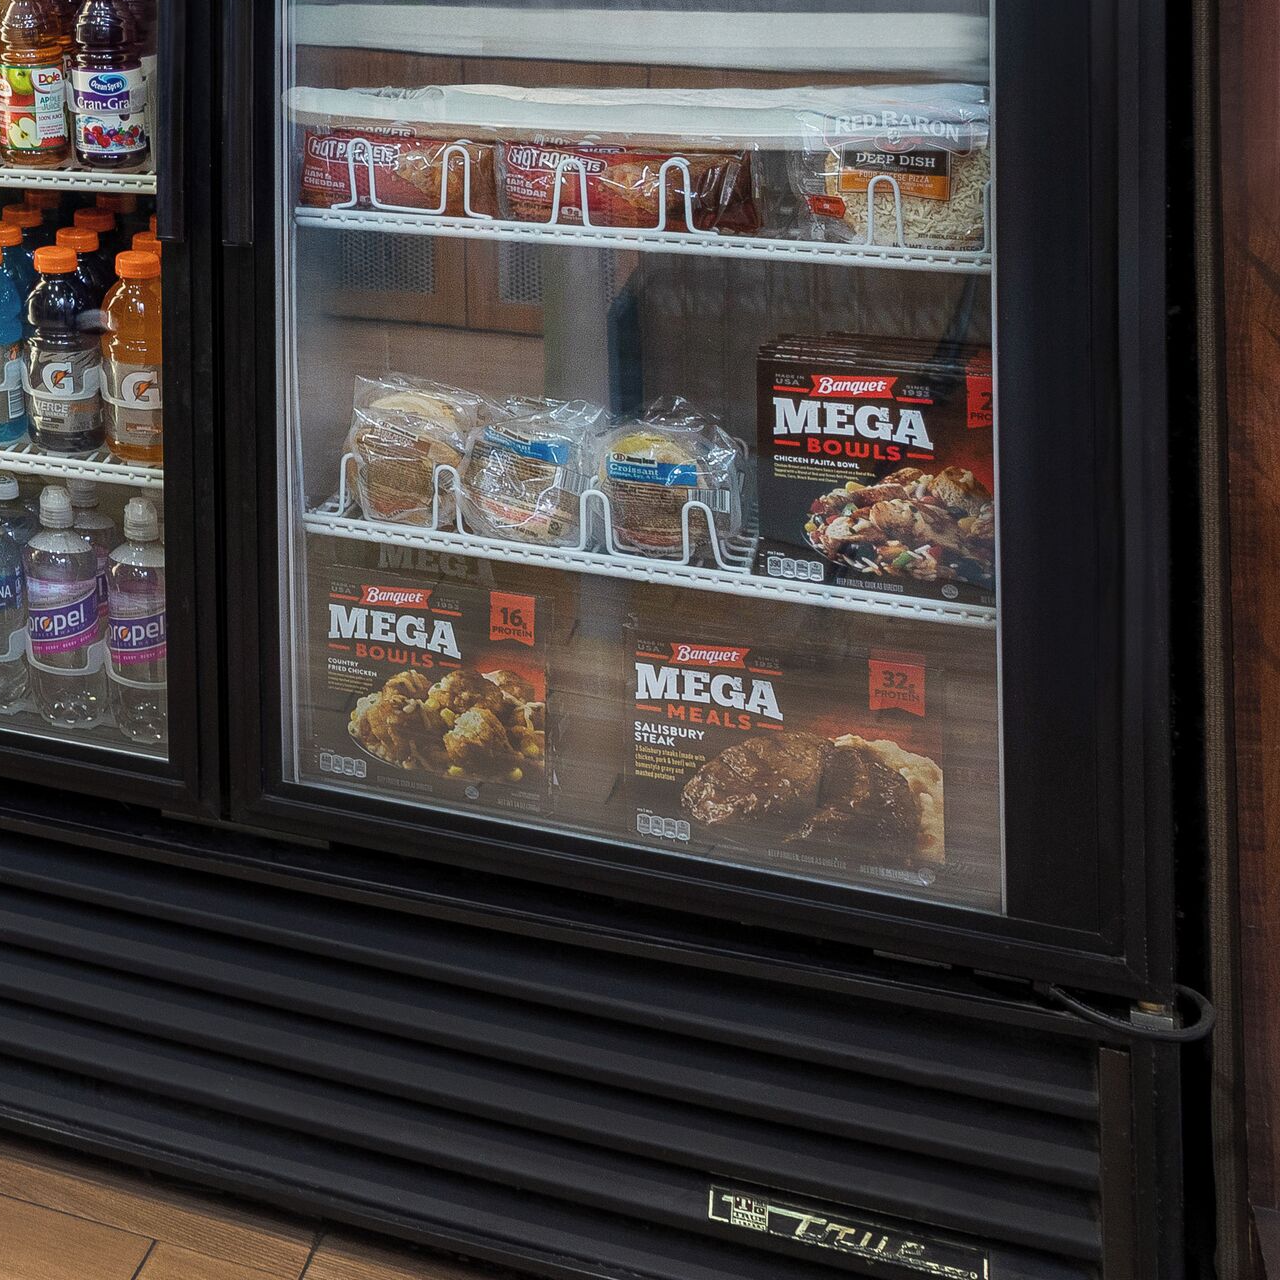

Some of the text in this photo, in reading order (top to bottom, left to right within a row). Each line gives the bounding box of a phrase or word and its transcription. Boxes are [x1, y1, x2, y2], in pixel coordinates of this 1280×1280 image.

[38, 72, 61, 85] Dole
[835, 111, 959, 143] RED BARON
[856, 152, 936, 168] DEEP DISH
[304, 176, 345, 189] CHEDDAR
[909, 175, 930, 183] PIZZA
[505, 185, 547, 198] CHEDDAR
[775, 378, 800, 386] USA
[818, 376, 886, 395] Banquet
[773, 397, 934, 450] MEGA
[807, 438, 901, 461] BOWLS
[774, 455, 860, 470] CHICKEN FAJITA BOWL
[366, 587, 423, 604] Banquet
[328, 604, 462, 659] MEGA
[492, 625, 533, 639] PROTEIN
[328, 657, 359, 667] COUNTRY
[356, 643, 434, 668] BOWLS
[677, 644, 739, 665] Banquet
[328, 664, 378, 677] FRIED CHICKEN
[635, 662, 783, 721] MEGA
[874, 688, 921, 703] PROTEIN
[666, 703, 753, 731] MEALS
[634, 721, 705, 740] SALISBURY
[634, 731, 676, 747] STEAK
